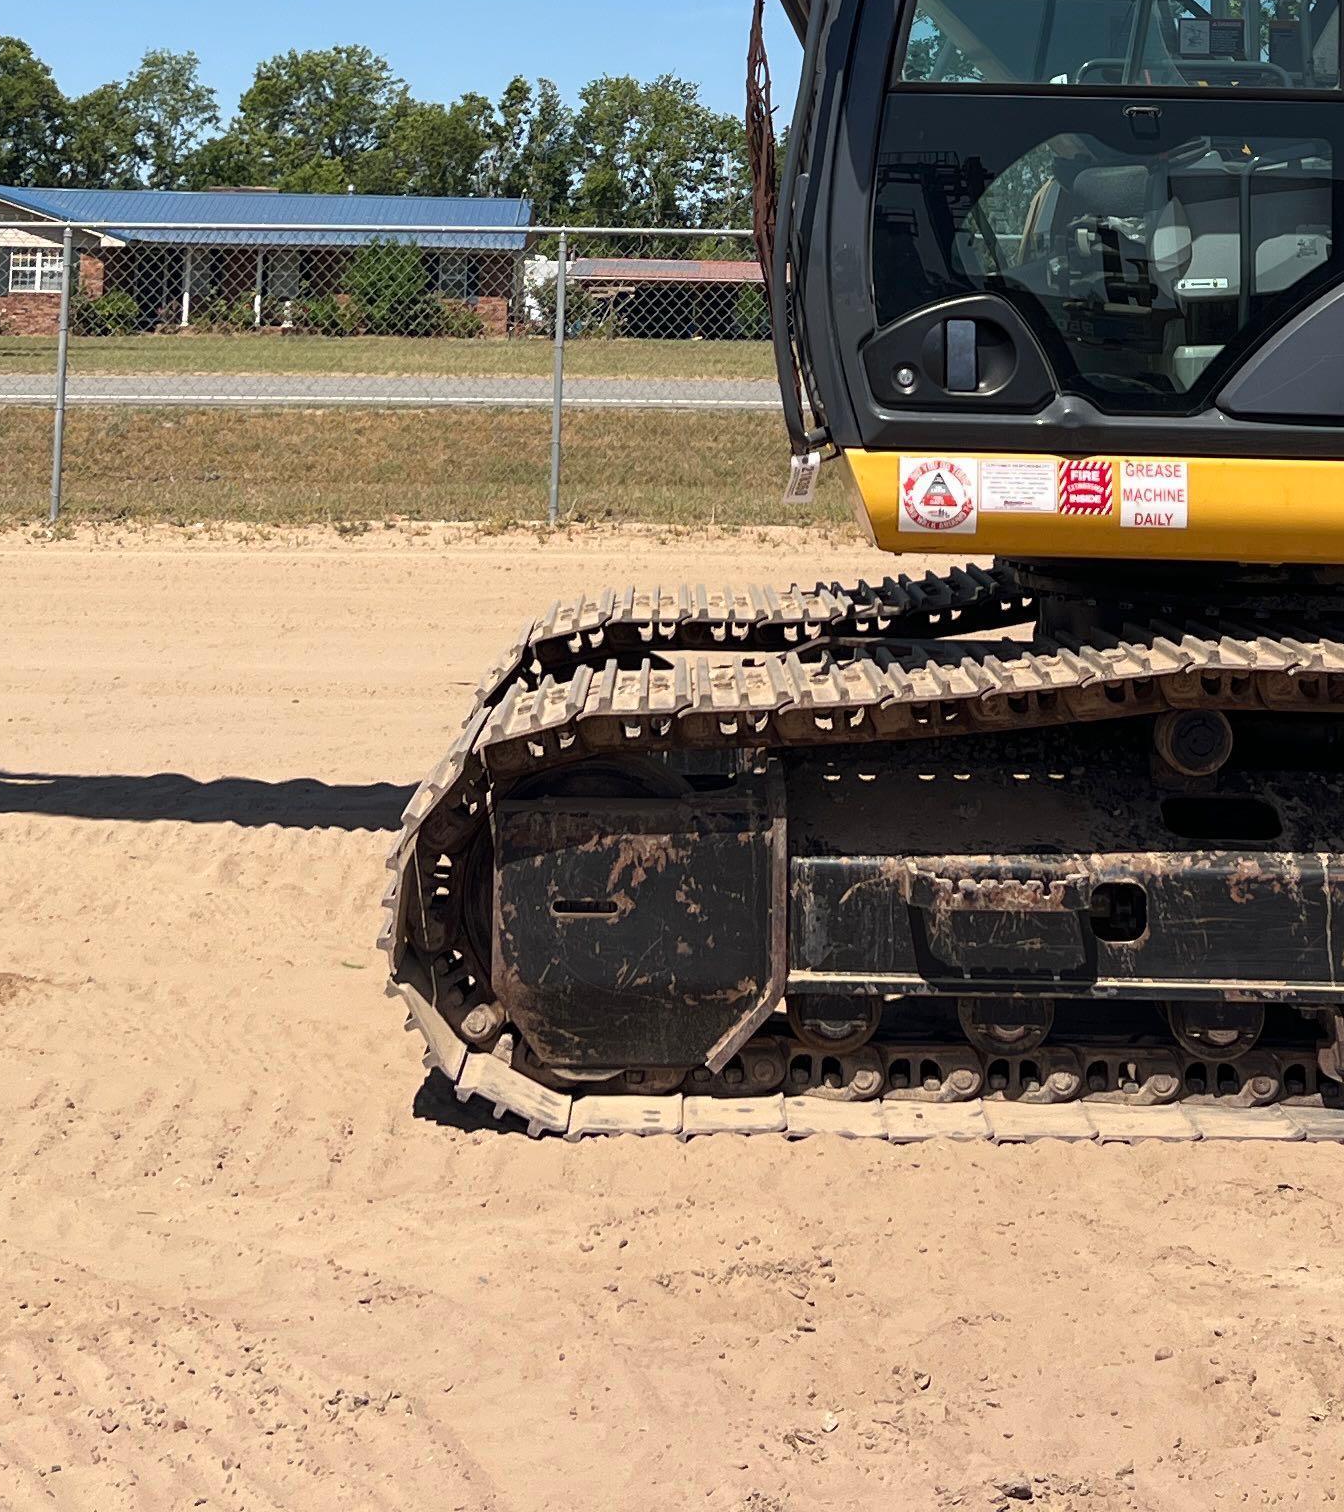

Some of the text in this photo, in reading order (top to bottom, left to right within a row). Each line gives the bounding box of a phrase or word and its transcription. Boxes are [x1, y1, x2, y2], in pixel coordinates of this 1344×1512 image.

[1070, 469, 1101, 482] FIRE
[1125, 462, 1182, 478] GREASE
[1123, 487, 1186, 503] MACHINE
[1134, 512, 1174, 526] DAILY
